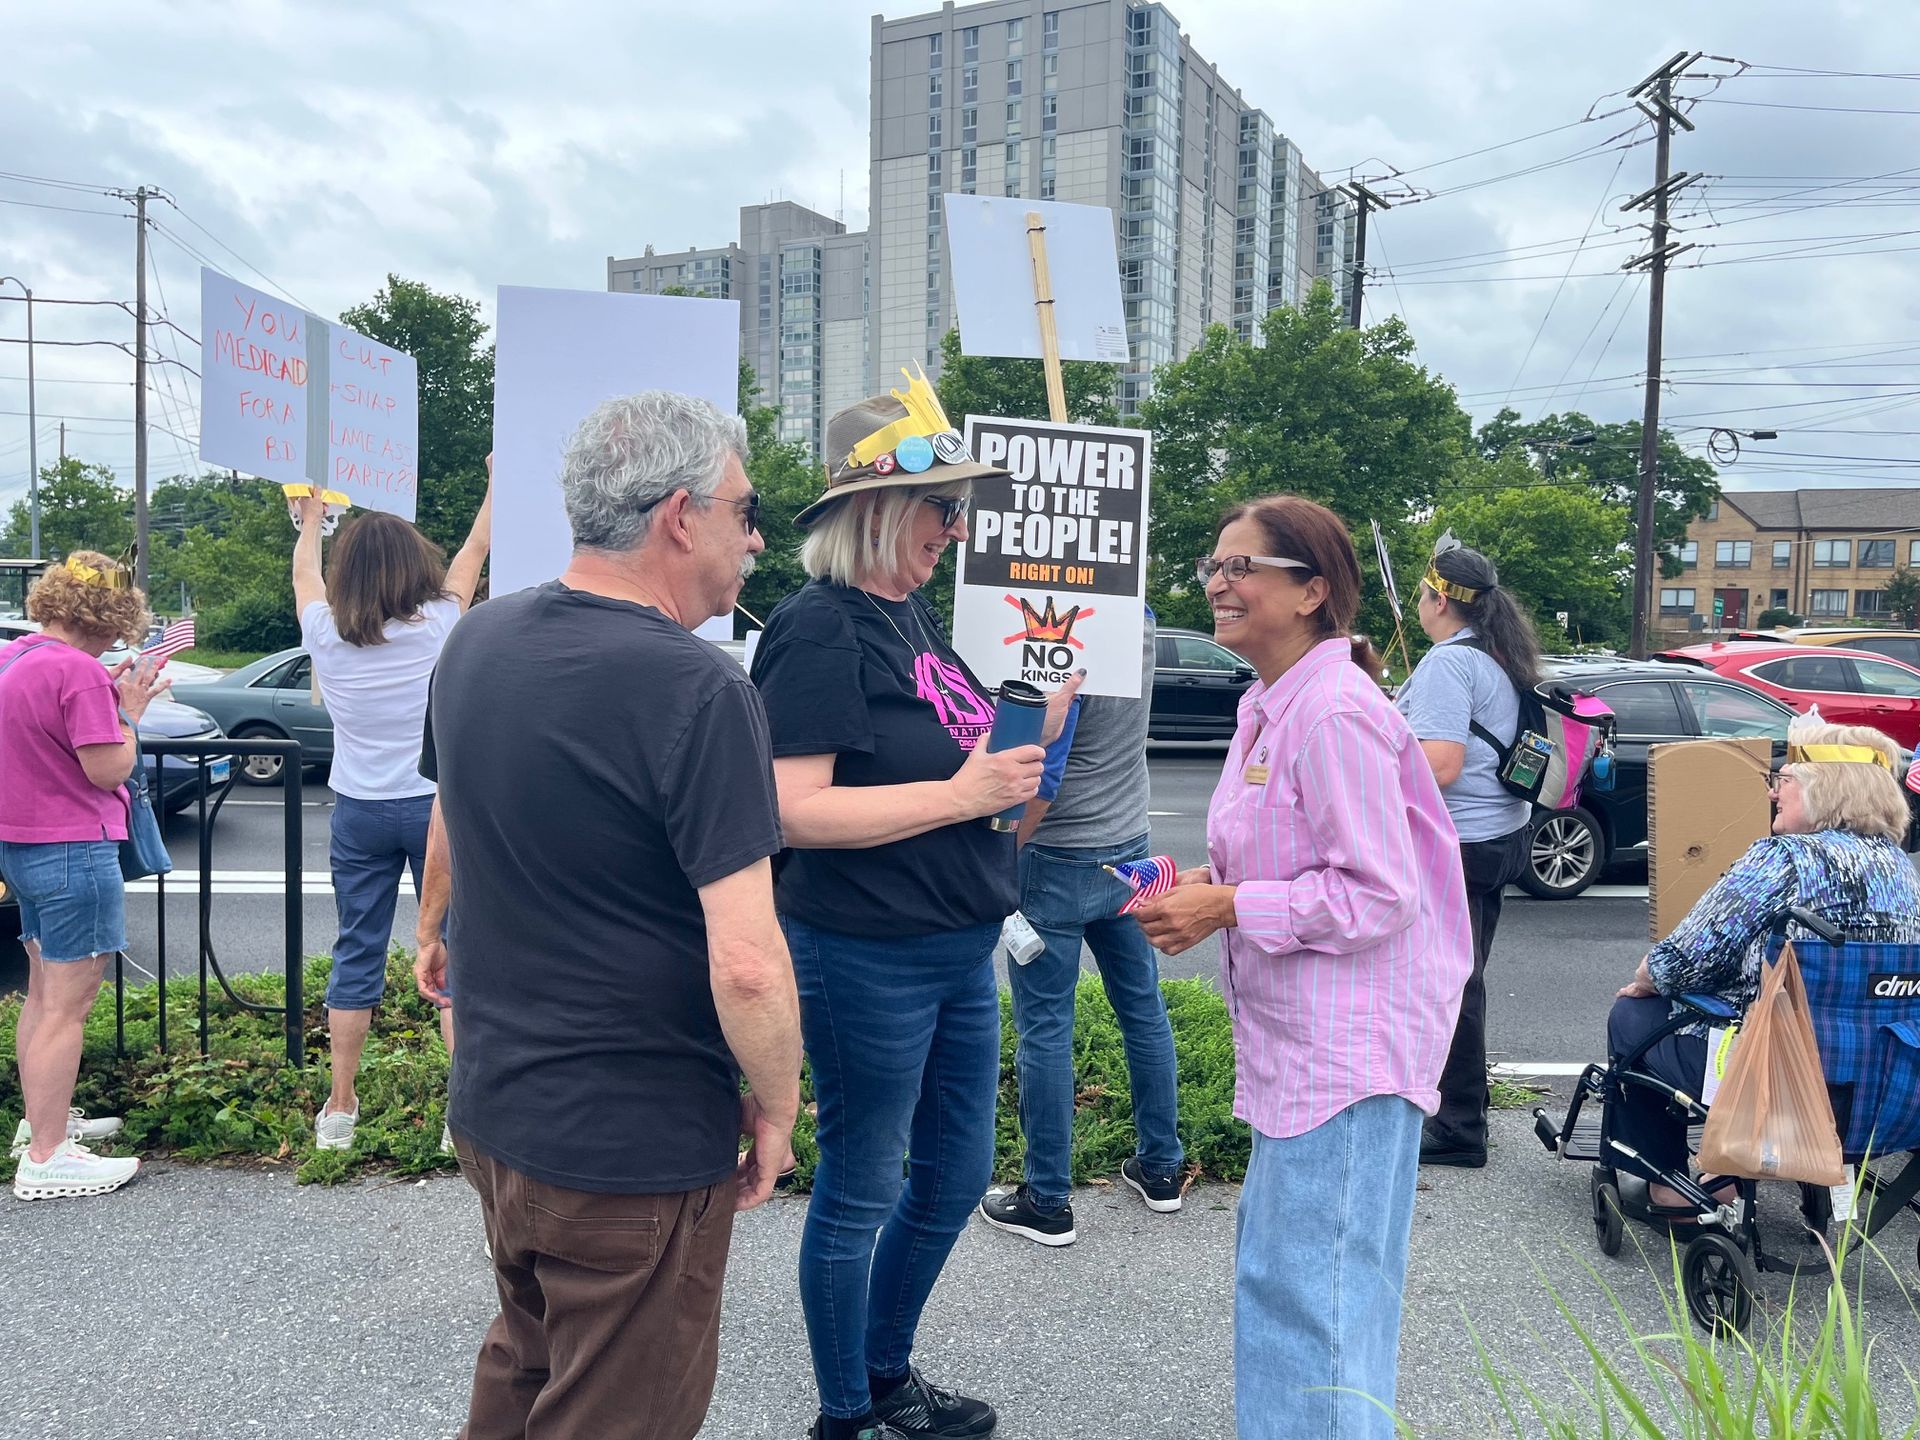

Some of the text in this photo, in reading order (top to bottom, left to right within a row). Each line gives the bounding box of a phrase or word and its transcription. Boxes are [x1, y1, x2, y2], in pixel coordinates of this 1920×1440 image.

[215, 328, 309, 386] MEDICAID
[234, 294, 393, 377] YOU CUT
[240, 390, 413, 468] FOR A LAME ASS
[979, 432, 1136, 490] POWER
[1011, 483, 1100, 517] TO THE
[974, 509, 1134, 565] PEOPLE!
[1009, 561, 1095, 585] RIGHT ON!
[1021, 643, 1074, 671] NO
[1021, 669, 1073, 684] KINGS
[1874, 975, 1920, 997] driv
